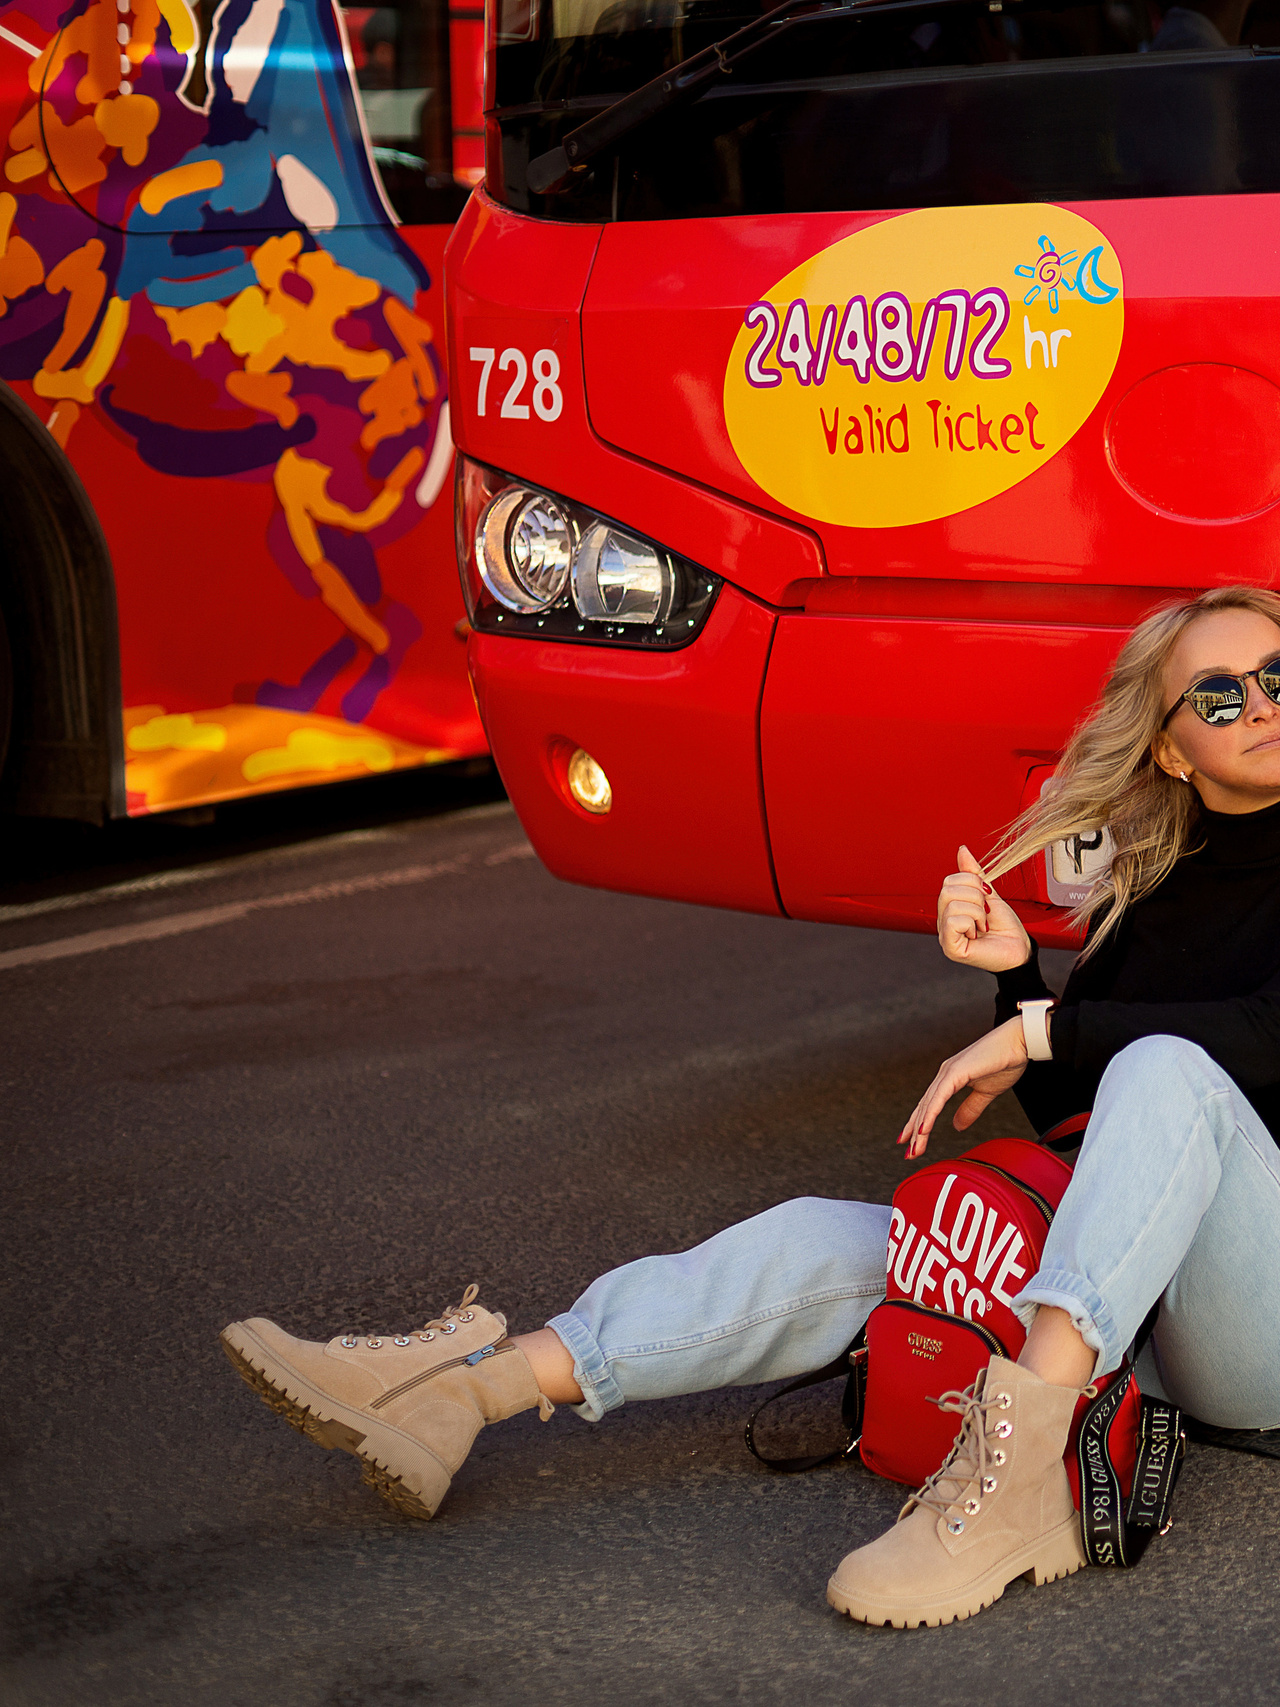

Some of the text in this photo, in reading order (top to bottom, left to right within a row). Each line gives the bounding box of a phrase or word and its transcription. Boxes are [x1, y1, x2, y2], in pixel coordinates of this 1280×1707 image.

[743, 286, 1072, 389] 24/48/72 hr
[469, 347, 564, 422] 728
[819, 399, 1046, 455] Valid Ticket
[929, 1173, 1027, 1309] LOVE
[907, 1332, 943, 1354] GUESS
[1092, 1486, 1112, 1534] 1981
